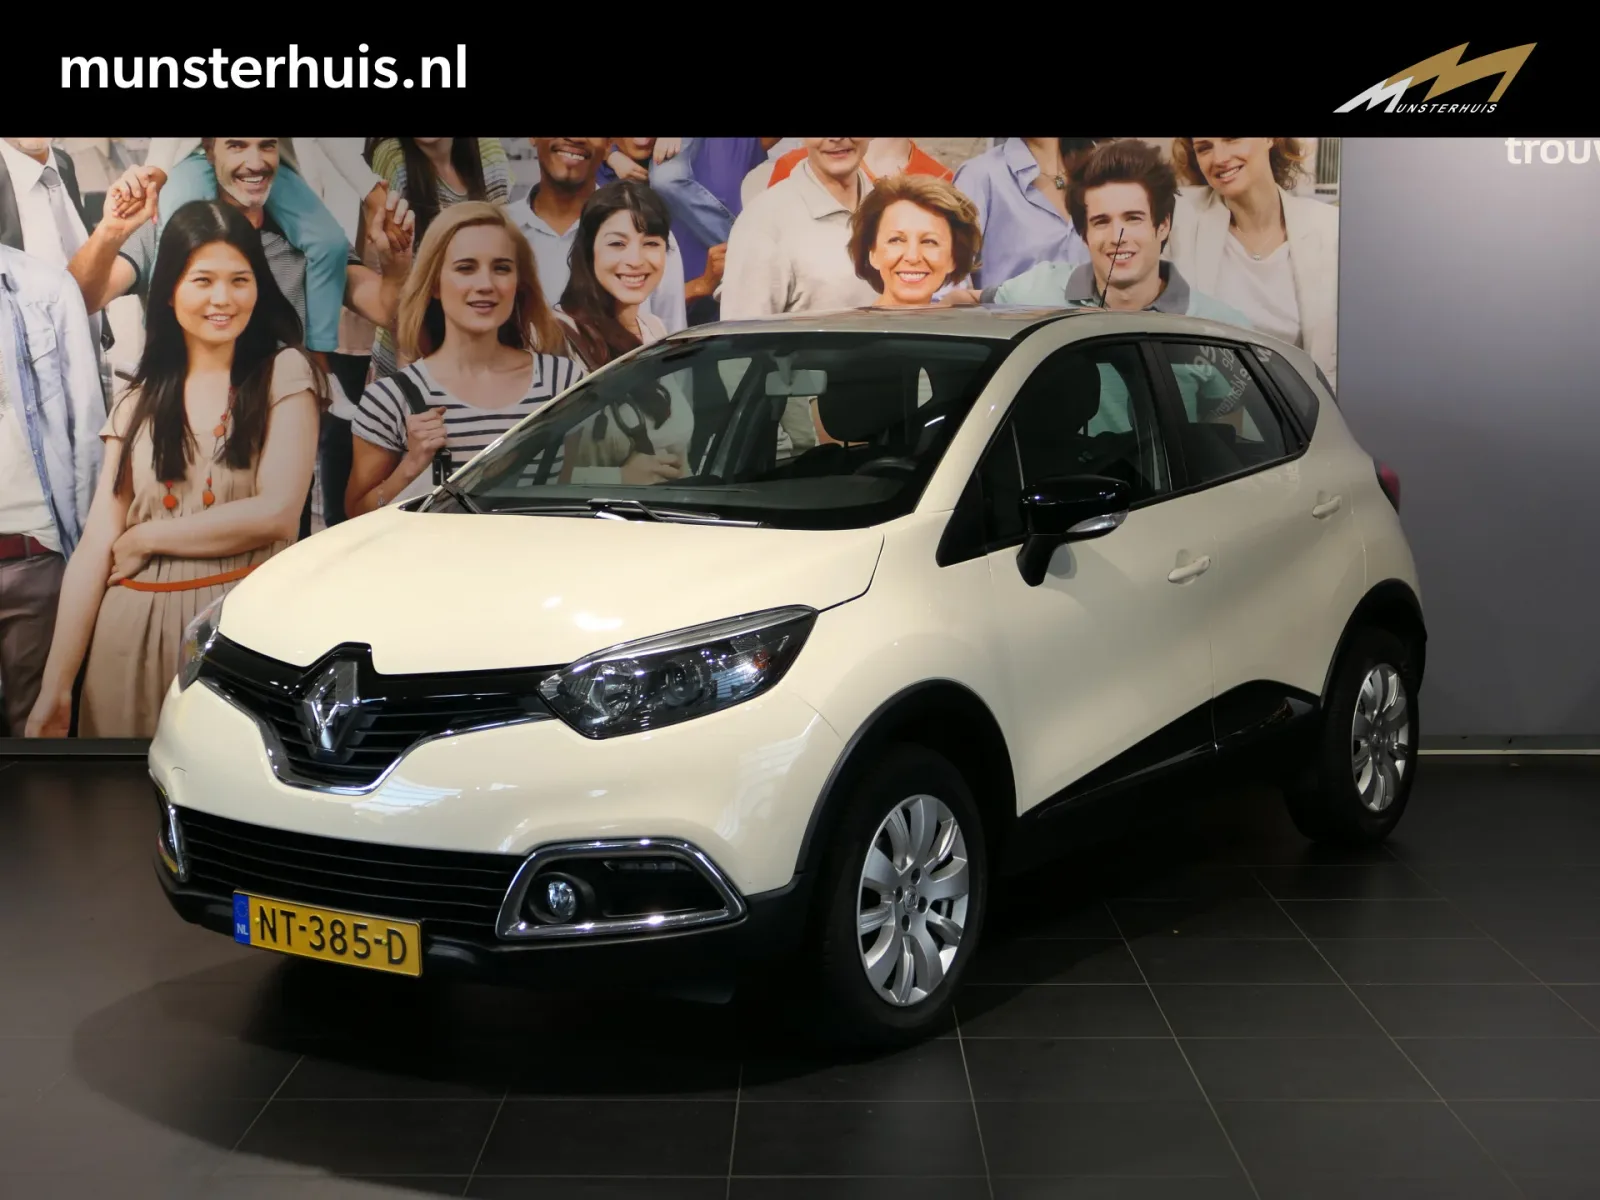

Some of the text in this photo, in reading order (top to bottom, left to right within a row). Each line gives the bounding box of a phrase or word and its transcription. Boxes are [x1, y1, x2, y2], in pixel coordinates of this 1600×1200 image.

[1505, 137, 1600, 164] trou
[236, 923, 249, 936] NL
[259, 905, 407, 965] NT-385-D
